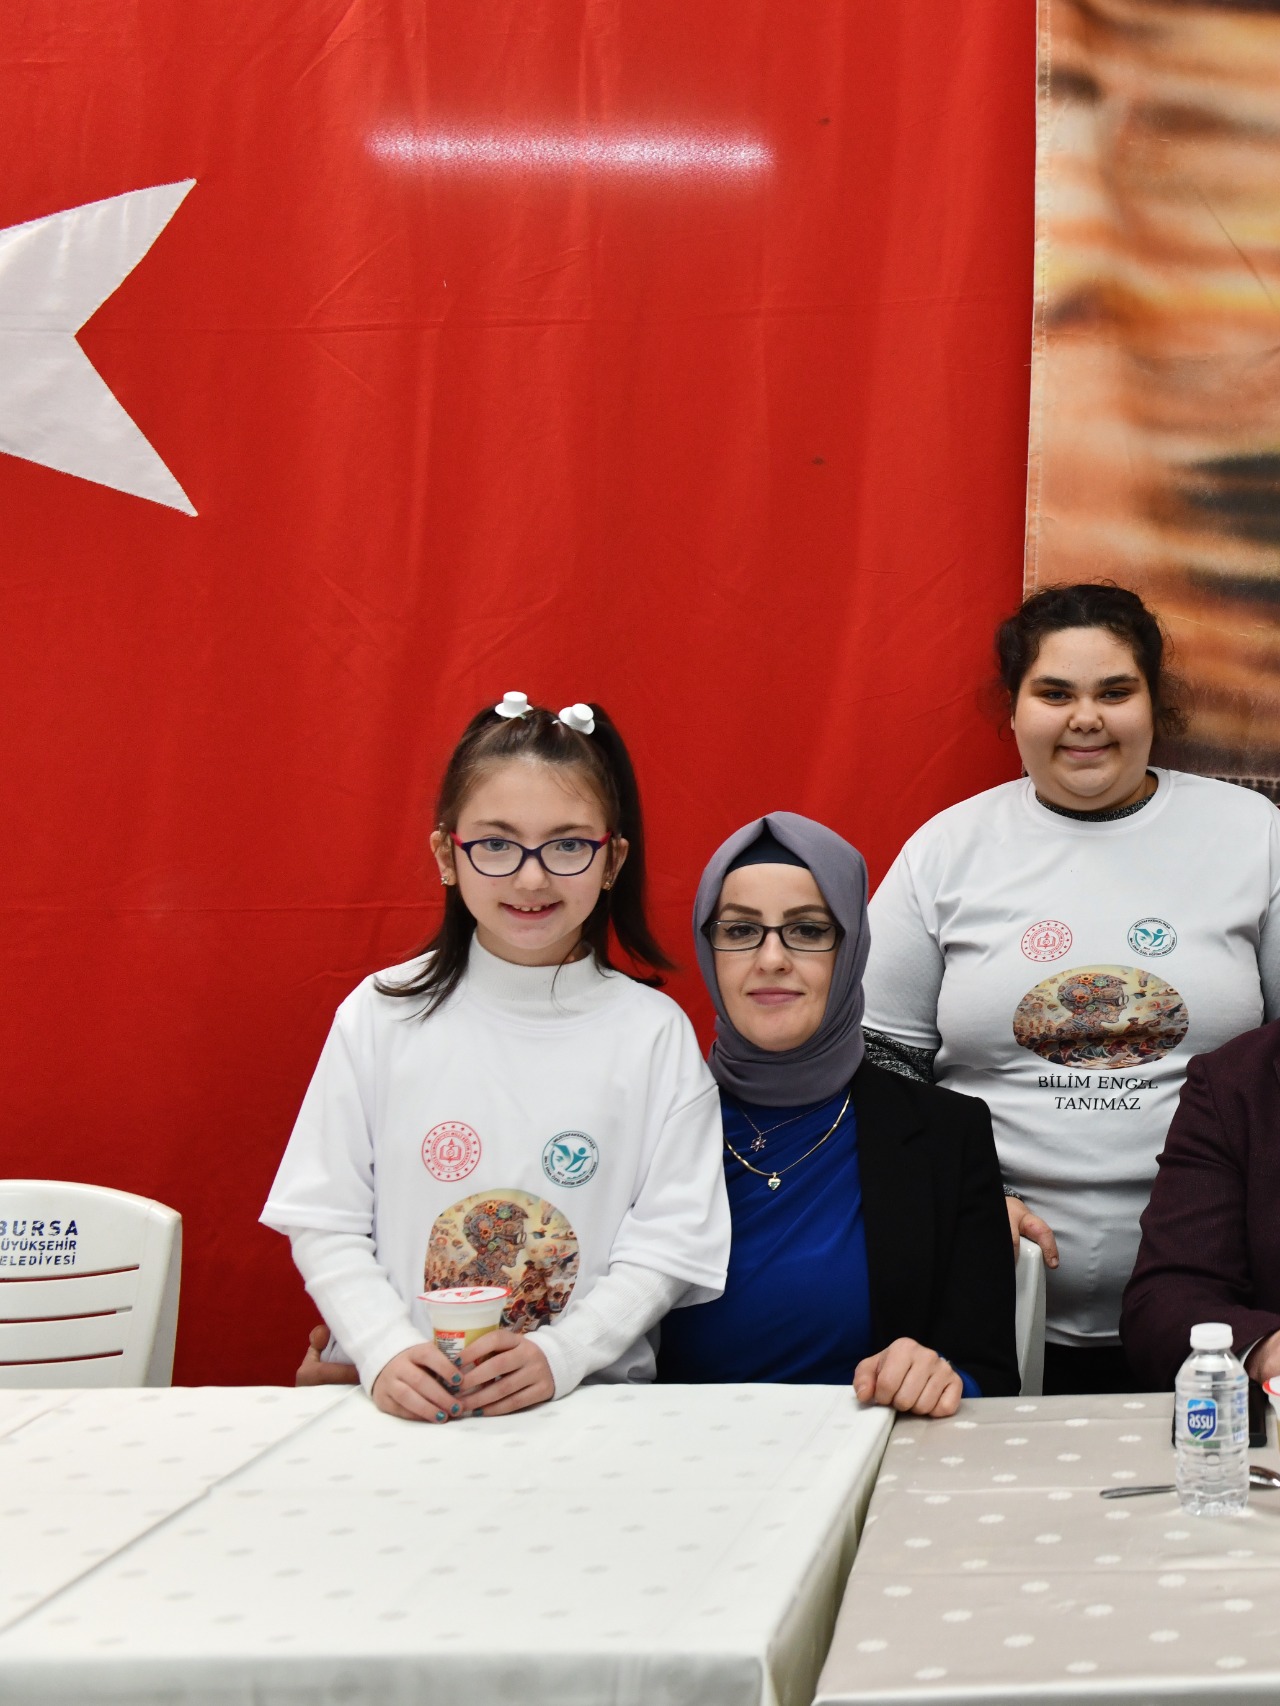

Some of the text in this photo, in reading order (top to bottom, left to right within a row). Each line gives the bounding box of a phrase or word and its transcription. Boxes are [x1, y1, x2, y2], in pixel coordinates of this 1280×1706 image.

[1038, 1073, 1158, 1090] BİLİM ENGEL
[1055, 1096, 1141, 1111] TANIMAZ
[1, 1237, 77, 1251] ÜYÜKŞEHİR
[0, 1252, 76, 1265] ELEDİYESİ
